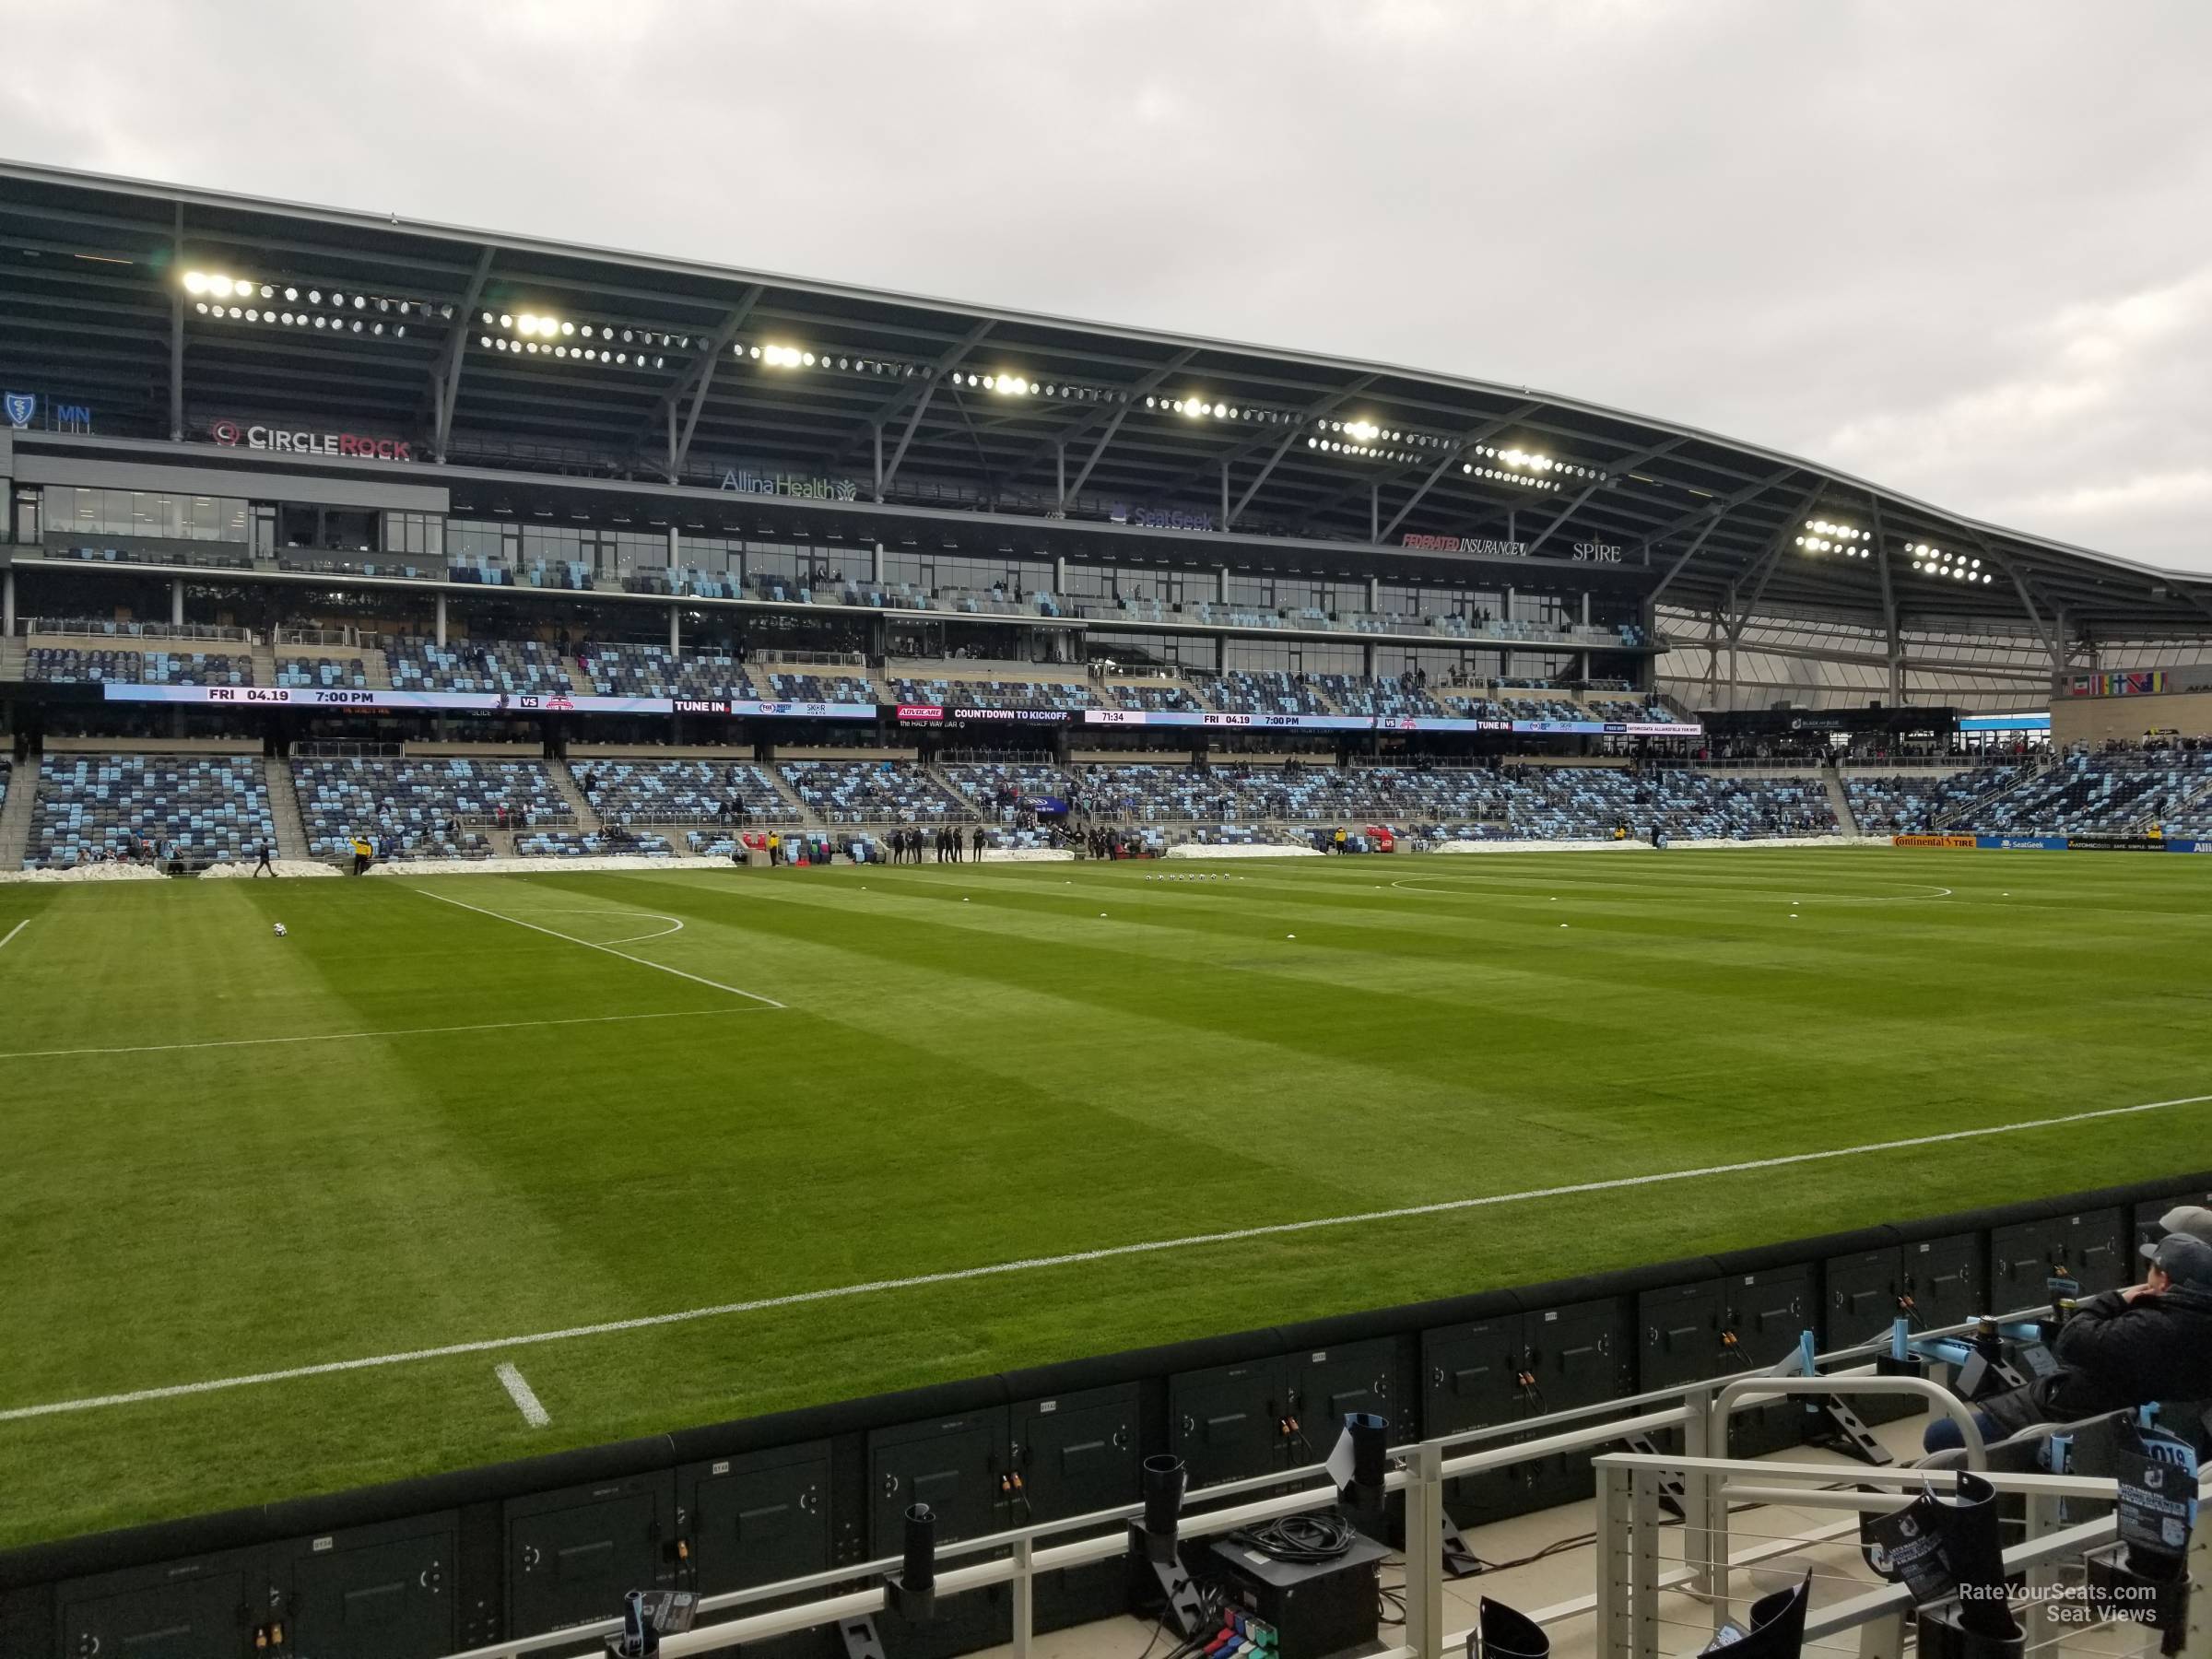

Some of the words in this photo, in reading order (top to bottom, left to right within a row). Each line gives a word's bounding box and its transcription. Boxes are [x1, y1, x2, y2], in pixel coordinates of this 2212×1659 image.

[58, 406, 90, 423] MN
[1135, 507, 1214, 530] SeatGeek
[1402, 533, 1460, 551] FEDERATED
[1461, 537, 1519, 556] INSURANCE
[1571, 543, 1622, 563] SPIRE
[209, 688, 234, 700] FRI
[247, 689, 288, 701] 04.19
[315, 691, 347, 702] 7:00
[351, 692, 373, 703] PM
[522, 698, 537, 707] VS
[675, 700, 710, 712] TUNE
[900, 708, 942, 716] ADVOCARE
[954, 709, 1015, 719] COUNTDOWN
[1016, 711, 1029, 720] TO
[1101, 712, 1124, 722] 71:34
[1204, 715, 1219, 724] FRI
[1226, 715, 1250, 724] 04.19
[1265, 716, 1284, 724] 7:00
[1477, 721, 1500, 729] TUNE
[1895, 836, 1944, 847] Continental
